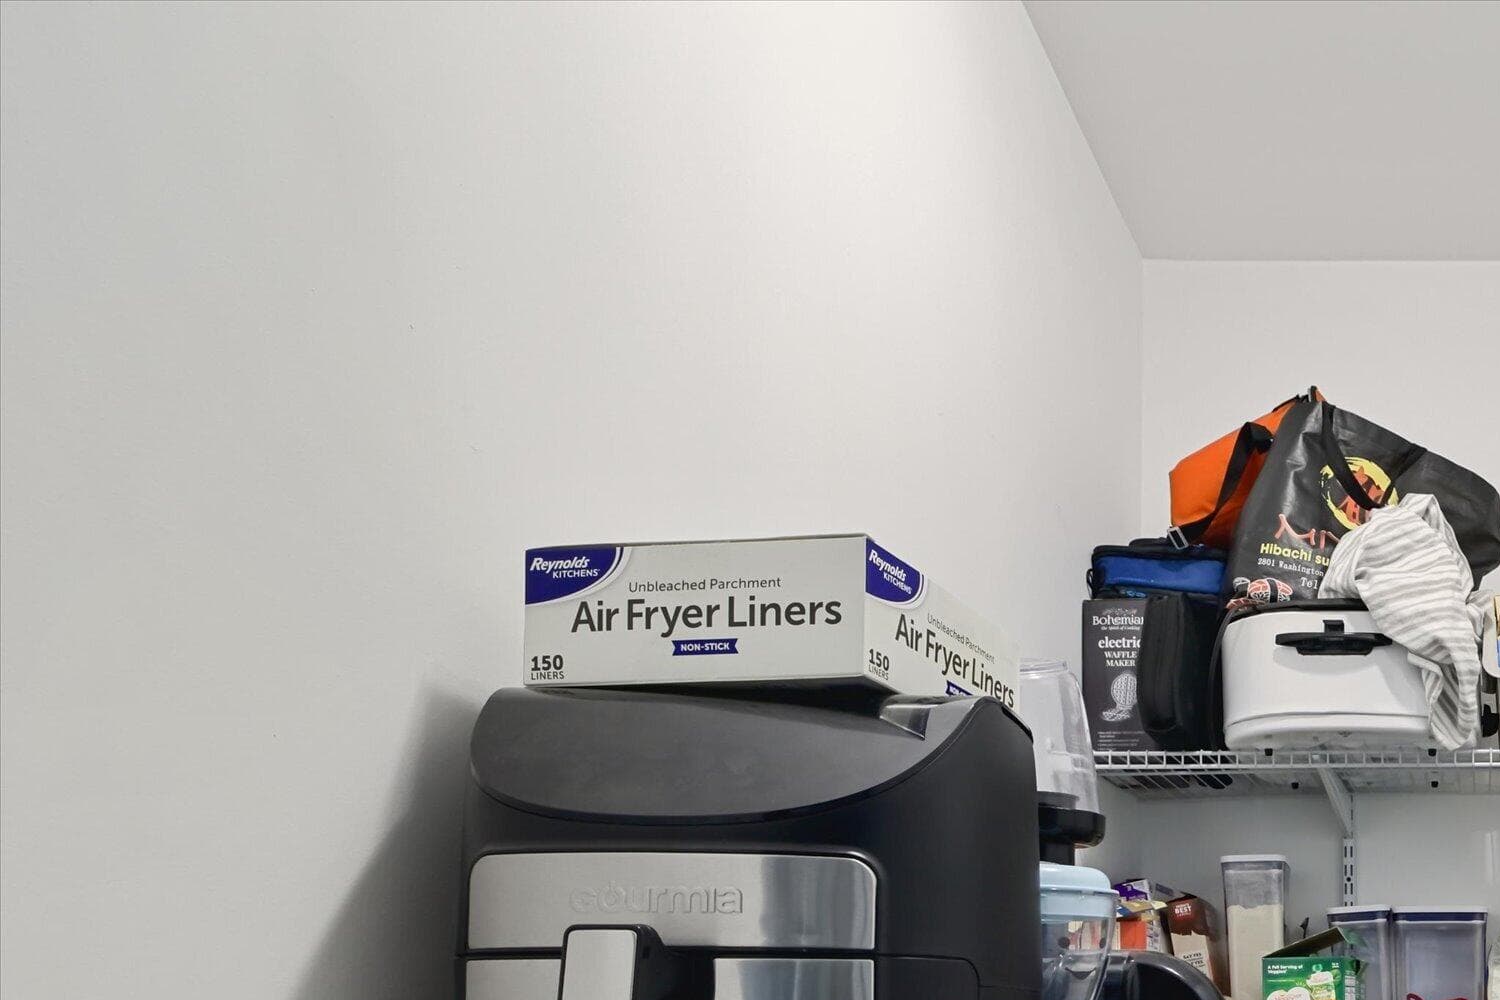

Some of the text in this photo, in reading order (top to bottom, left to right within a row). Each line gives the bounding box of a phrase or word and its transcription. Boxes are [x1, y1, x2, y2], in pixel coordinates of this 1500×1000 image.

[1260, 543, 1330, 567] Hibachi su
[530, 556, 590, 573] Reynolds
[869, 550, 907, 582] Reynolds
[1258, 557, 1324, 577] 2801 Washington
[552, 569, 599, 579] KITCHENS
[629, 577, 782, 593] Unbleached Parchment
[883, 572, 912, 595] KITCHENS
[1300, 577, 1318, 589] Tel
[571, 595, 842, 638] Air Fryer Liners
[680, 642, 730, 652] NON-STICK
[927, 613, 995, 664] Unbleached Parchment
[531, 655, 564, 671] 150
[869, 648, 889, 671] 150
[895, 613, 1014, 708] Air Fryer Liners
[1104, 651, 1137, 659] WAFFLE
[1106, 659, 1136, 667] MAKER
[531, 671, 565, 681] LINERS
[868, 664, 889, 681] LINERS
[1174, 906, 1192, 914] BEST
